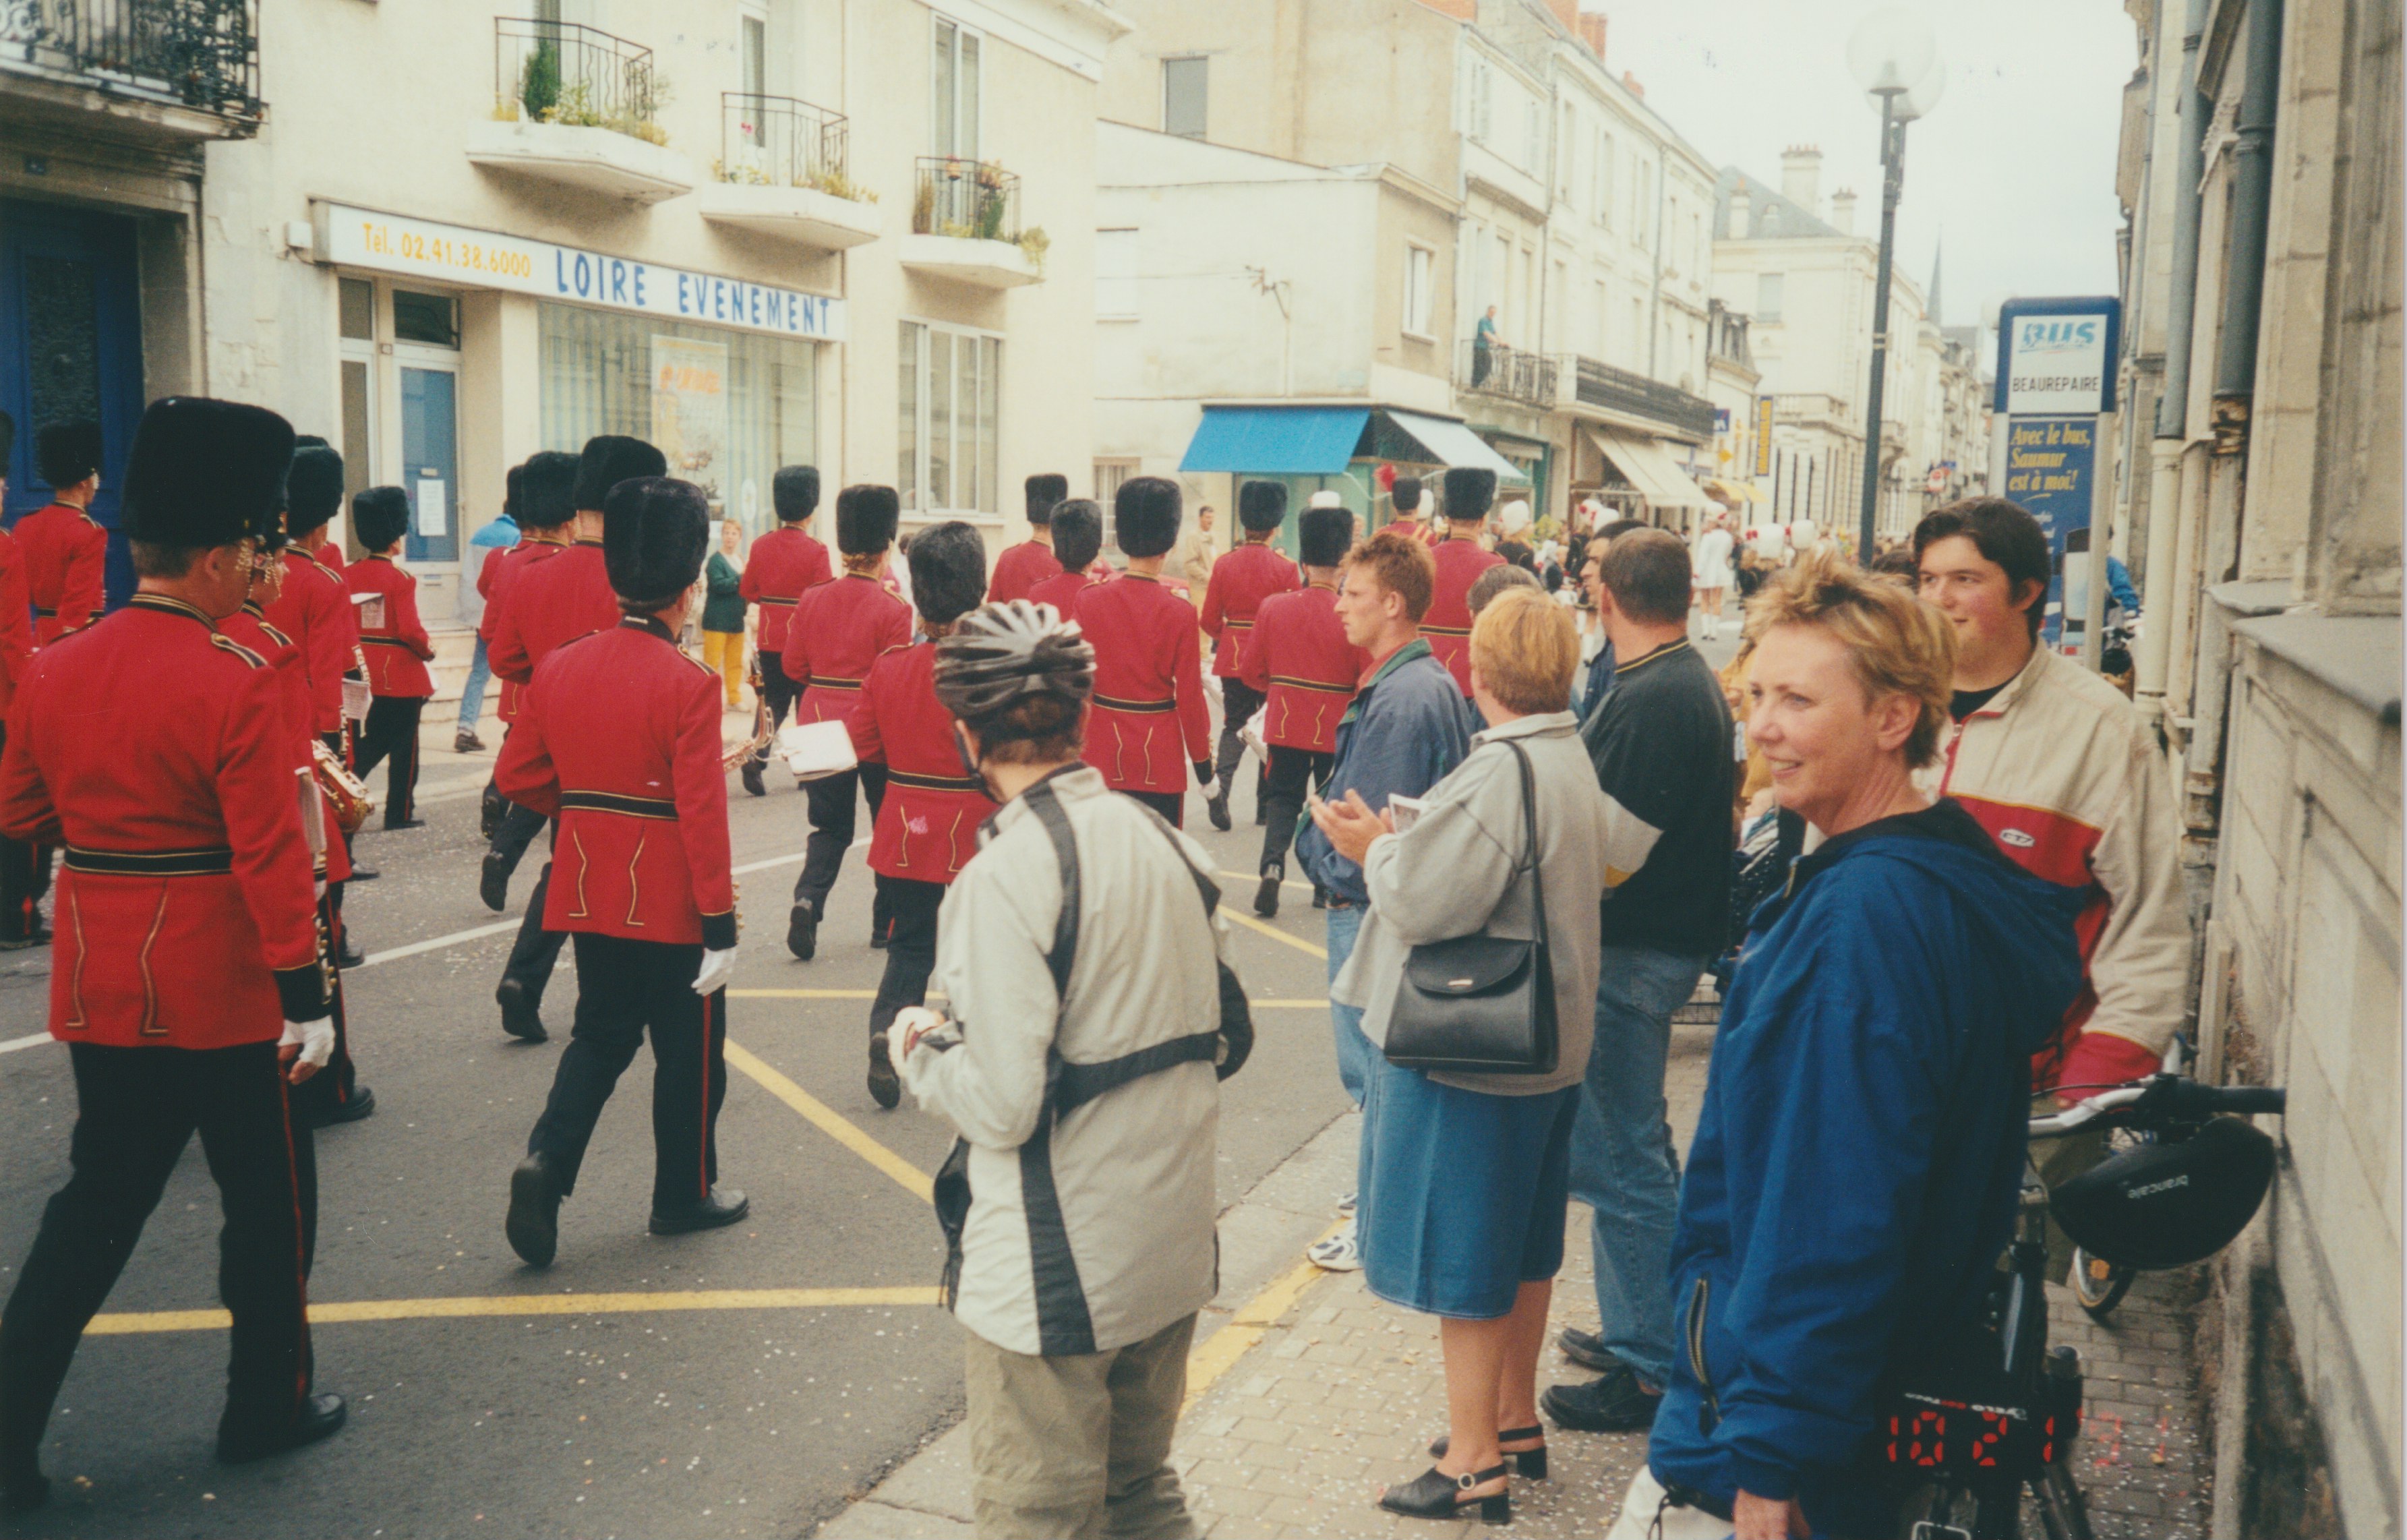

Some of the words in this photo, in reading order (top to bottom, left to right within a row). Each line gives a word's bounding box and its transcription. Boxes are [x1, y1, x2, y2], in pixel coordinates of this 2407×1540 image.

[362, 222, 394, 256] Tél.
[400, 231, 531, 279] 02.41.38.6000
[556, 248, 647, 306] LOIRE
[678, 272, 829, 334] EVENEMENT
[2022, 322, 2096, 346] BUS
[2012, 376, 2099, 392] BEAUREPAIRE
[2009, 425, 2044, 446] Avec
[2046, 423, 2061, 445] le
[2061, 423, 2091, 448] bus,
[2010, 447, 2067, 469] Saumur
[2009, 473, 2030, 492] est
[2030, 469, 2042, 491] à
[2043, 469, 2079, 491] moi!
